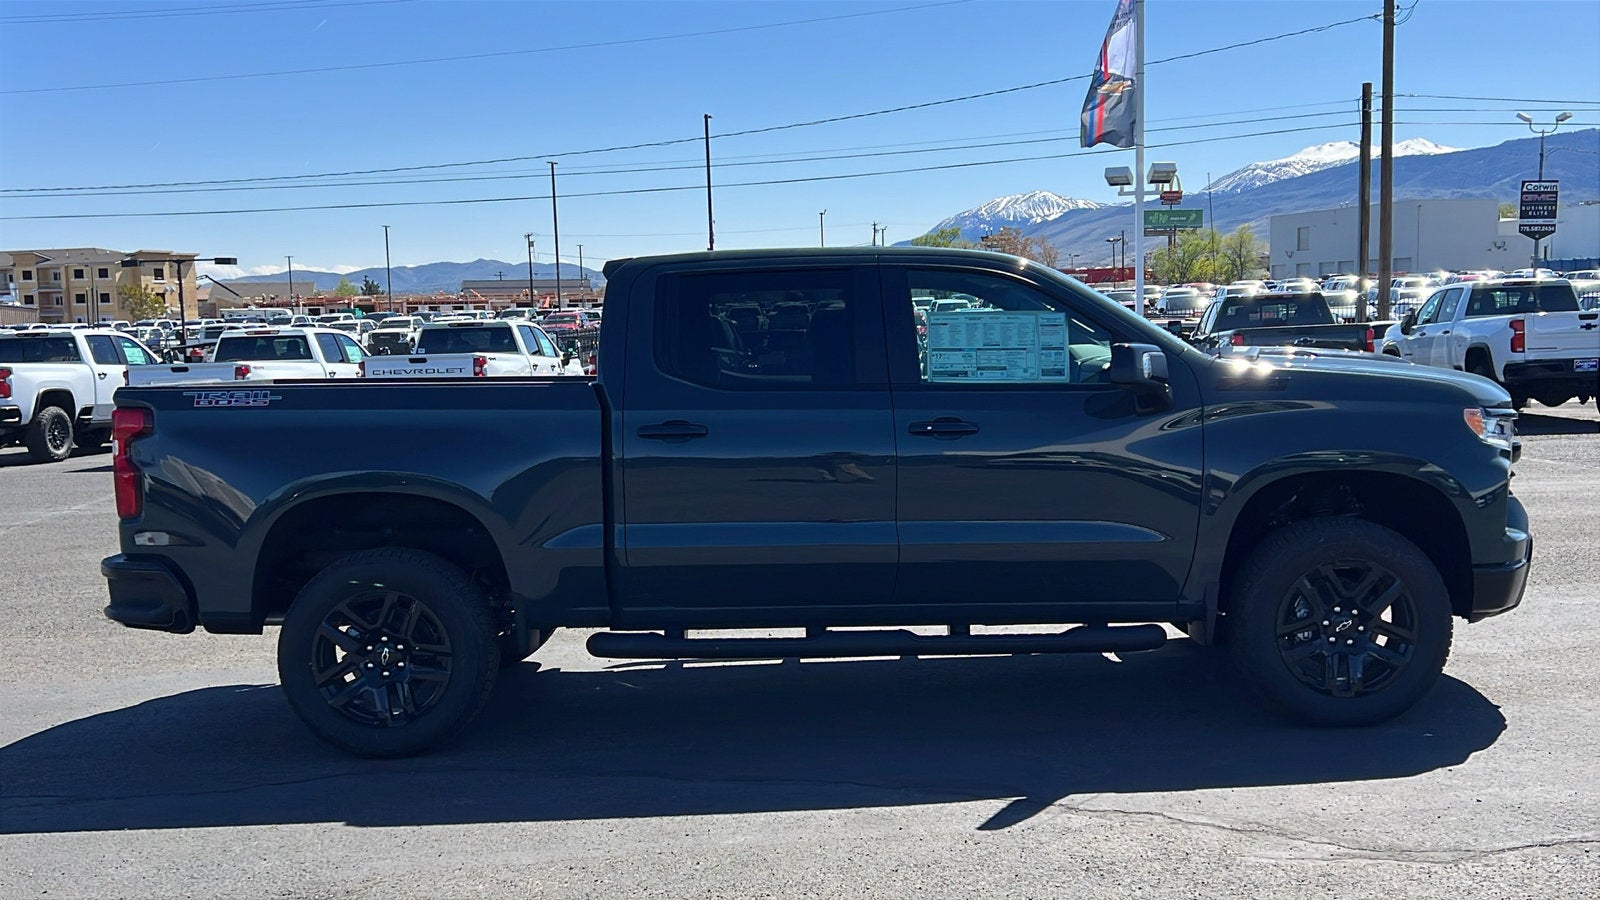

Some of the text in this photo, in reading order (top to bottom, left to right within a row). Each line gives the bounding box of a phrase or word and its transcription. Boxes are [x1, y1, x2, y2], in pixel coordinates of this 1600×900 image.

[372, 367, 466, 376] CHEVROLET
[183, 390, 282, 400] TRAIL
[193, 399, 270, 407] BOSS
